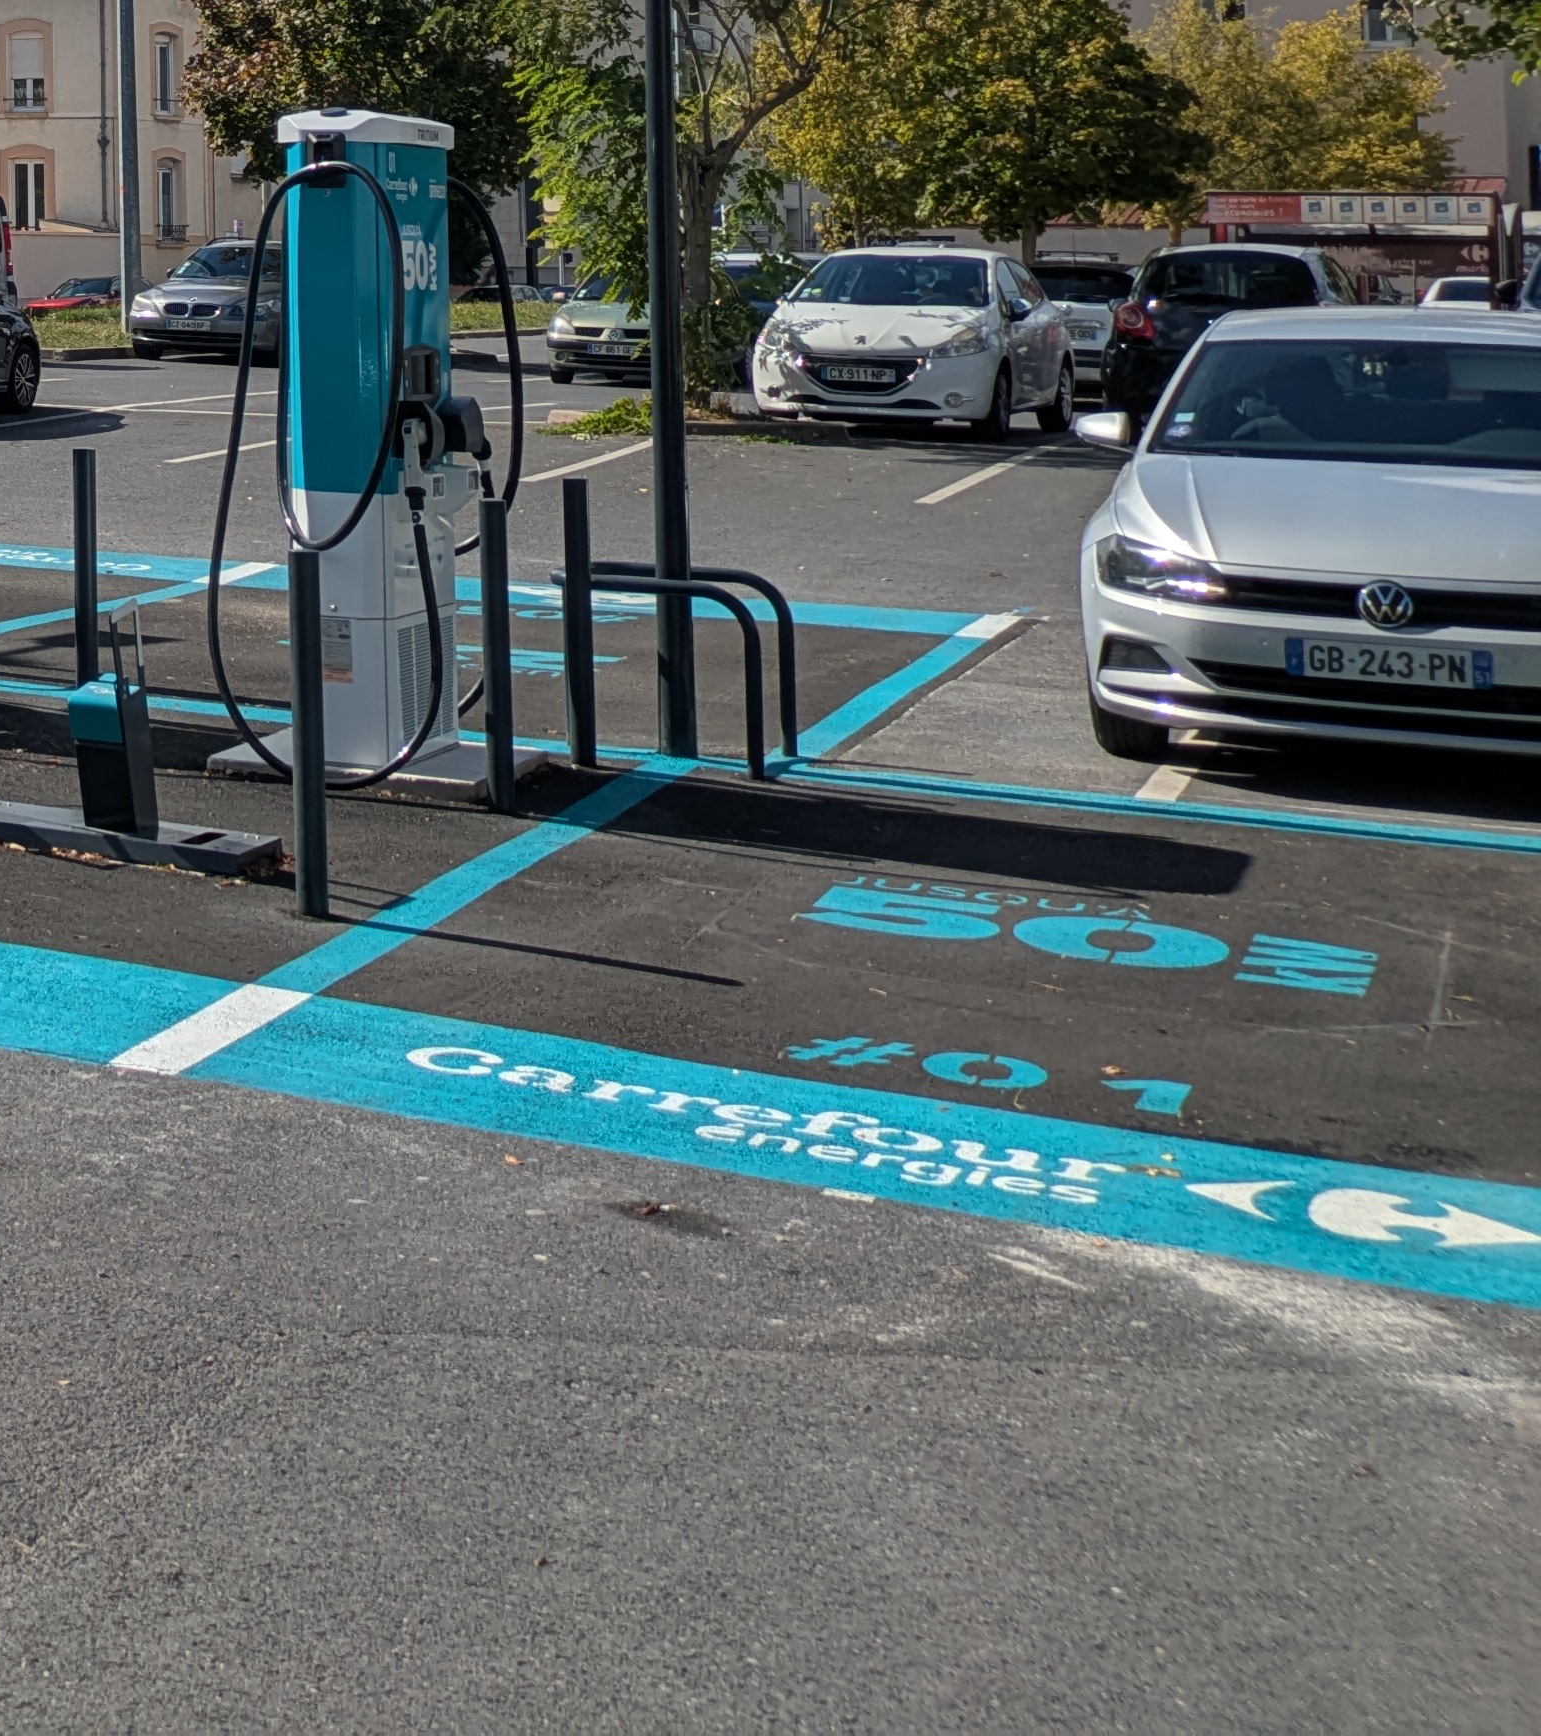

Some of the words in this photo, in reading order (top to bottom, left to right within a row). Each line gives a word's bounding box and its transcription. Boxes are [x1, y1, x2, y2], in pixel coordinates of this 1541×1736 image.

[402, 238, 429, 292] 50
[1308, 644, 1467, 684] GB-243-PN
[1475, 670, 1491, 684] 51
[795, 884, 1231, 969] 50
[405, 1045, 1127, 1182] Carrefour
[784, 1035, 1193, 1116] #01
[694, 1122, 1099, 1205] énergies
